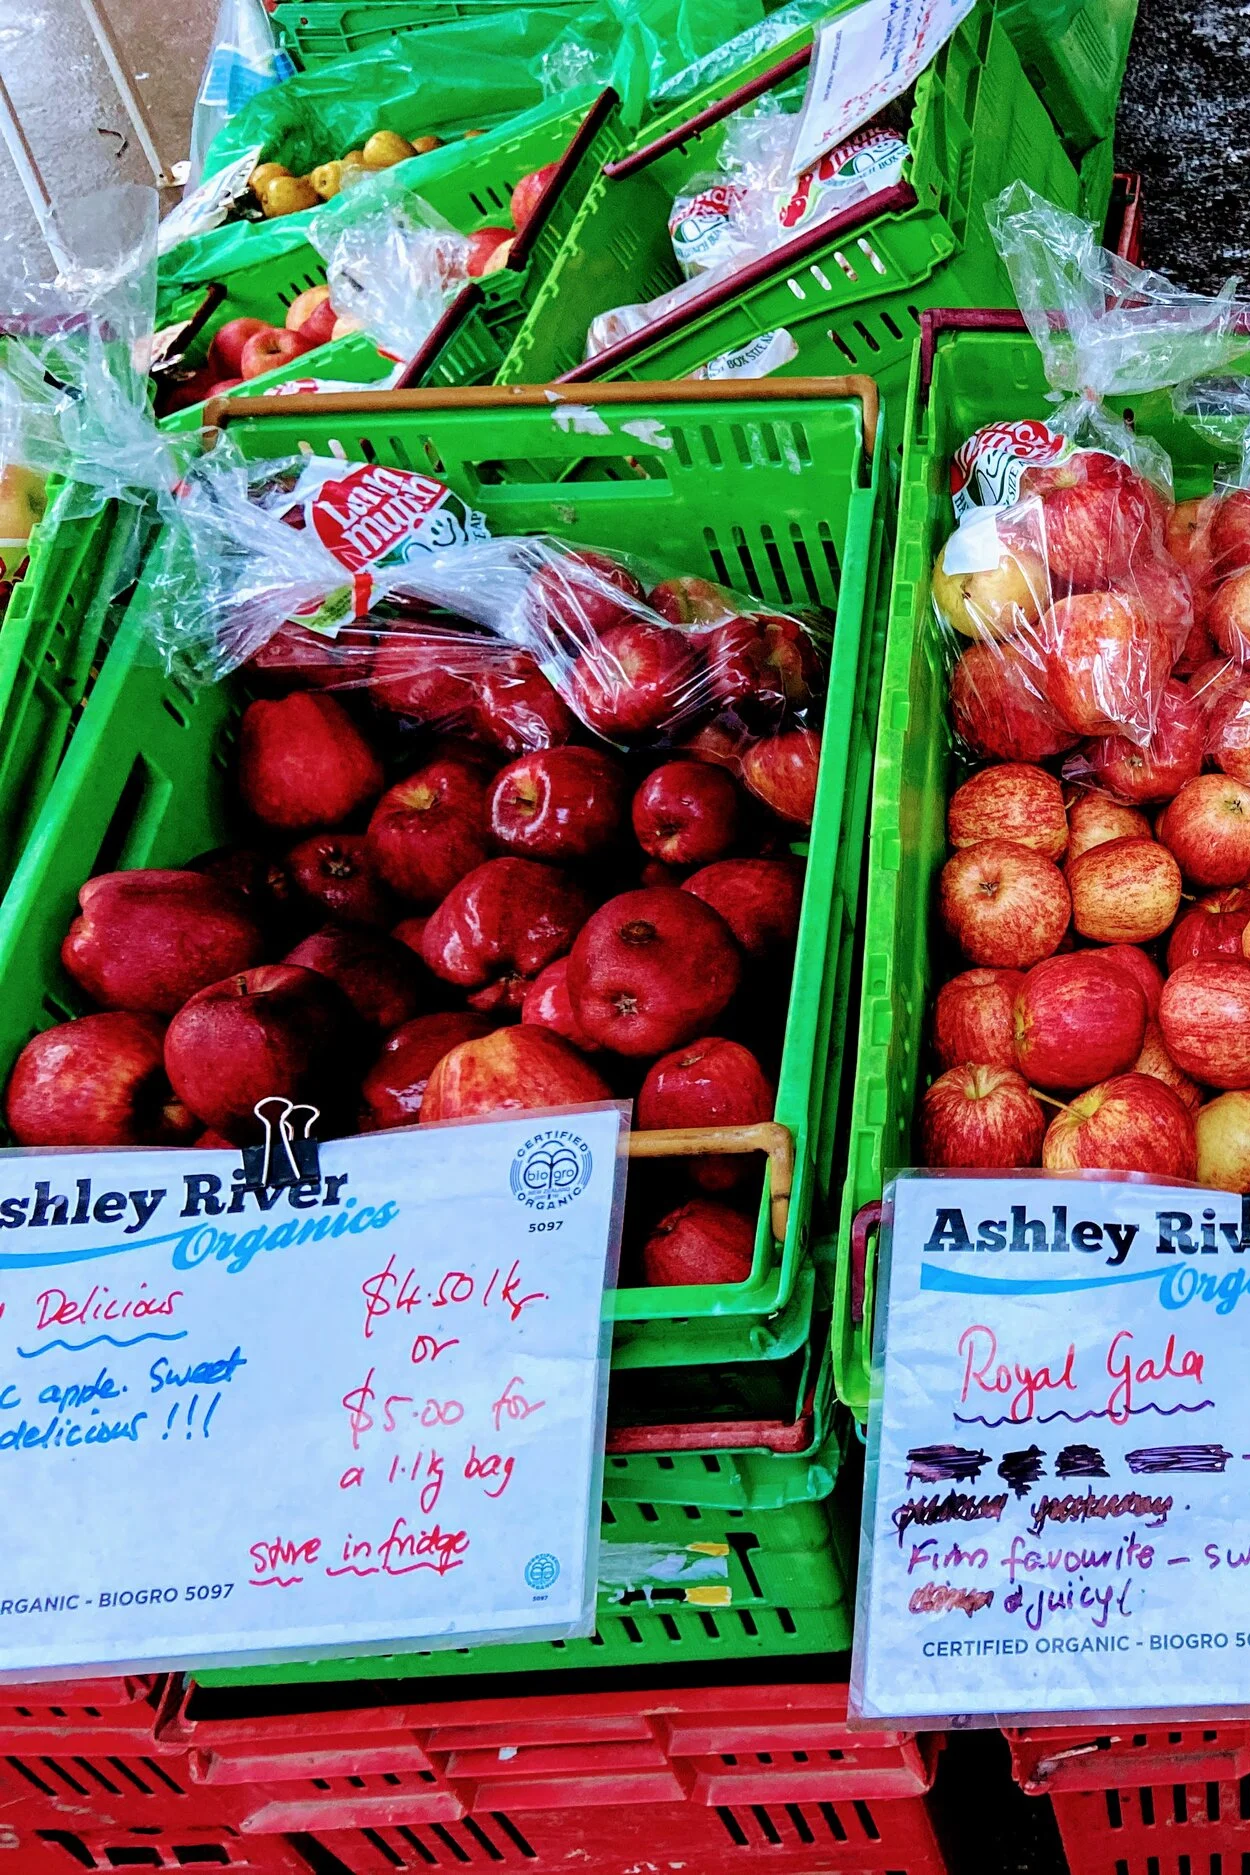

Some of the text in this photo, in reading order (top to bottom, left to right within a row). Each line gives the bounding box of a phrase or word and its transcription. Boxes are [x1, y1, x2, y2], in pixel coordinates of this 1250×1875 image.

[726, 343, 768, 370] BOX SIZE
[517, 1131, 588, 1158] CERTIFIED
[0, 1178, 167, 1234] shley
[517, 1186, 582, 1210] ORGANIC
[172, 1197, 400, 1274] Organics
[528, 1220, 564, 1233] 5097
[923, 1205, 1140, 1267] Ashley
[36, 1282, 185, 1330] Delicious
[411, 1335, 460, 1364] or
[958, 1324, 1206, 1426] Royal Gala
[343, 1367, 546, 1450] $5.00 for
[340, 1467, 365, 1489] a
[464, 1445, 515, 1498] bag
[342, 1532, 372, 1561] in
[377, 1517, 470, 1576] fridge
[907, 1537, 989, 1575] Firm
[1000, 1530, 1155, 1584] favourite
[0, 1595, 80, 1615] RGANIC
[99, 1588, 178, 1608] BIOGRO
[184, 1583, 235, 1601] 5097
[922, 1639, 1029, 1657] CERTIFIED
[1035, 1635, 1130, 1654] ORGANIC
[1149, 1633, 1229, 1650] BIOGRO
